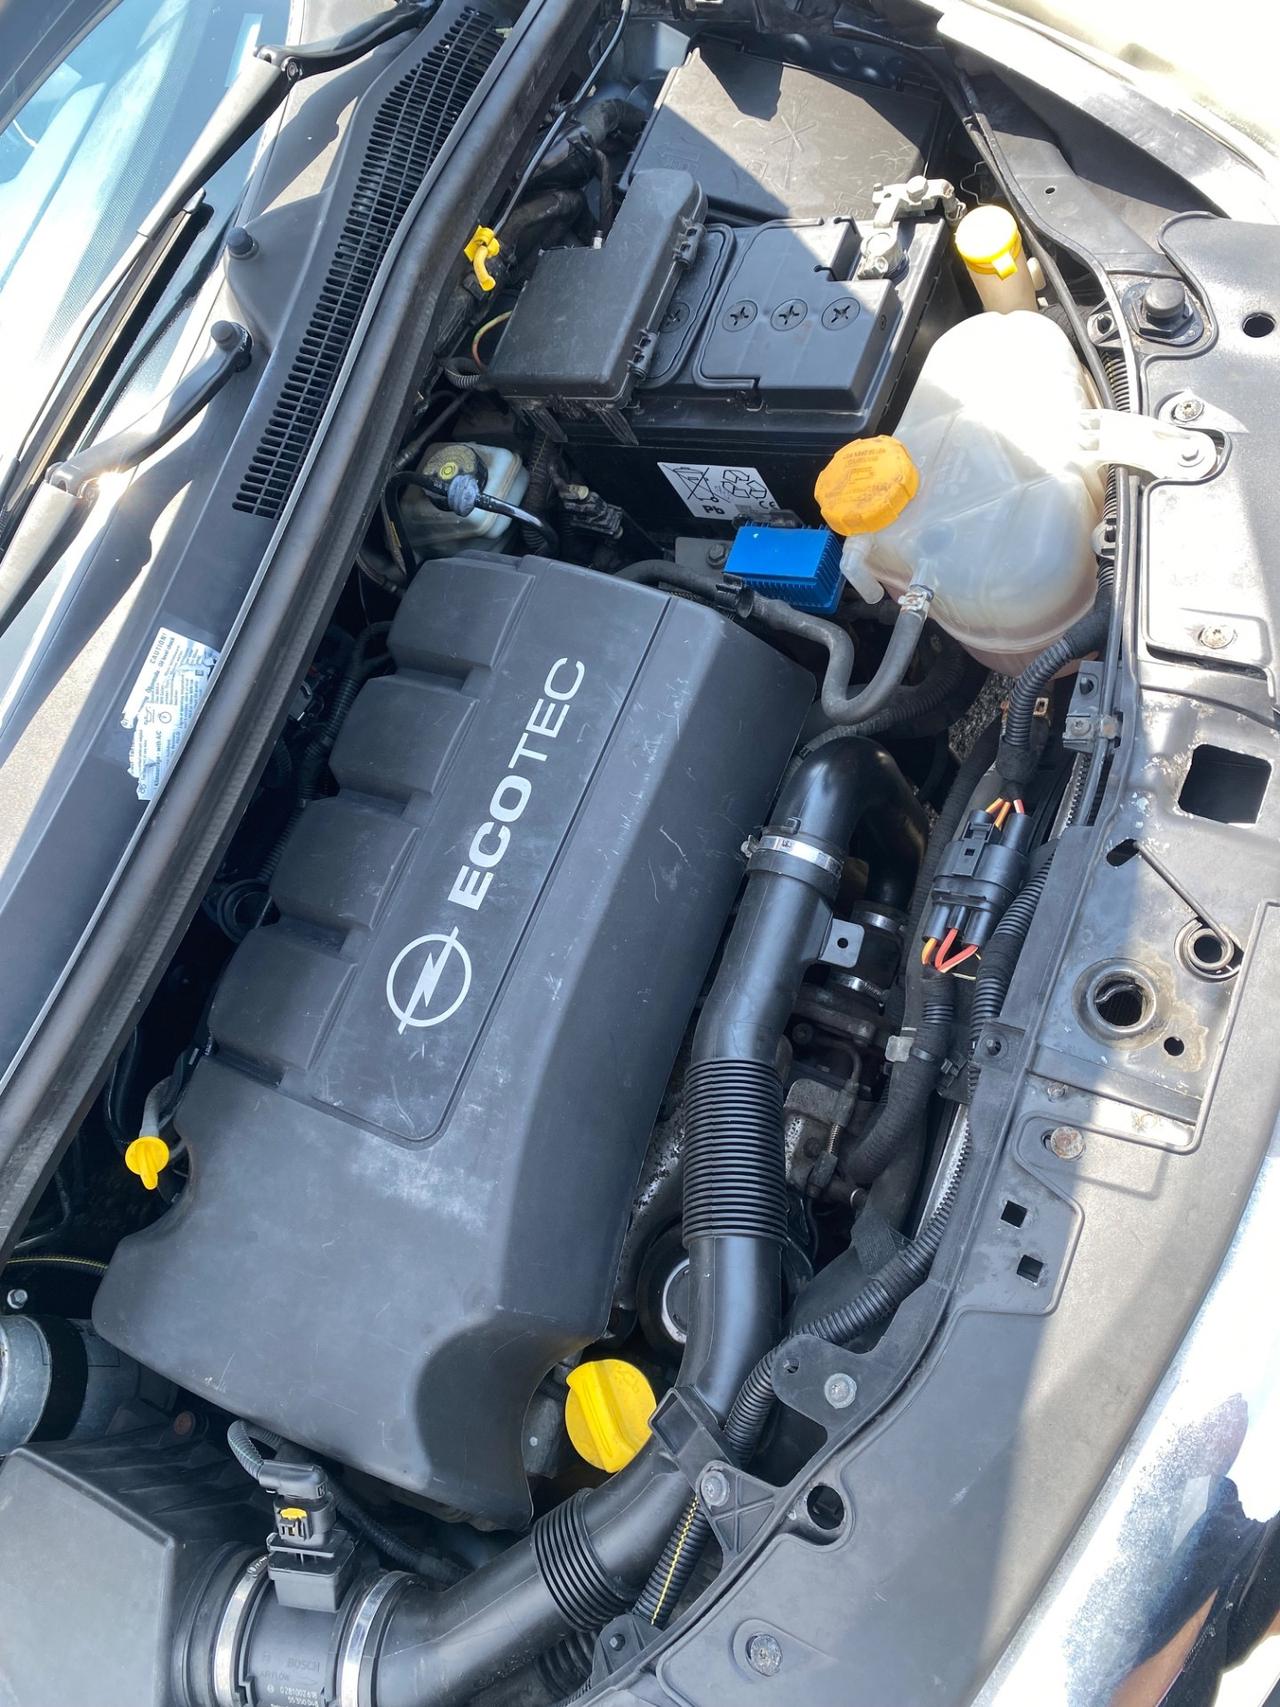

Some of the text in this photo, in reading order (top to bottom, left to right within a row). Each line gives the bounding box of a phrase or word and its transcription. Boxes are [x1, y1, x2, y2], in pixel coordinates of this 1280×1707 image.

[702, 504, 725, 515] Pb
[150, 632, 168, 664] CAUTION!
[447, 657, 585, 911] ECOTEC
